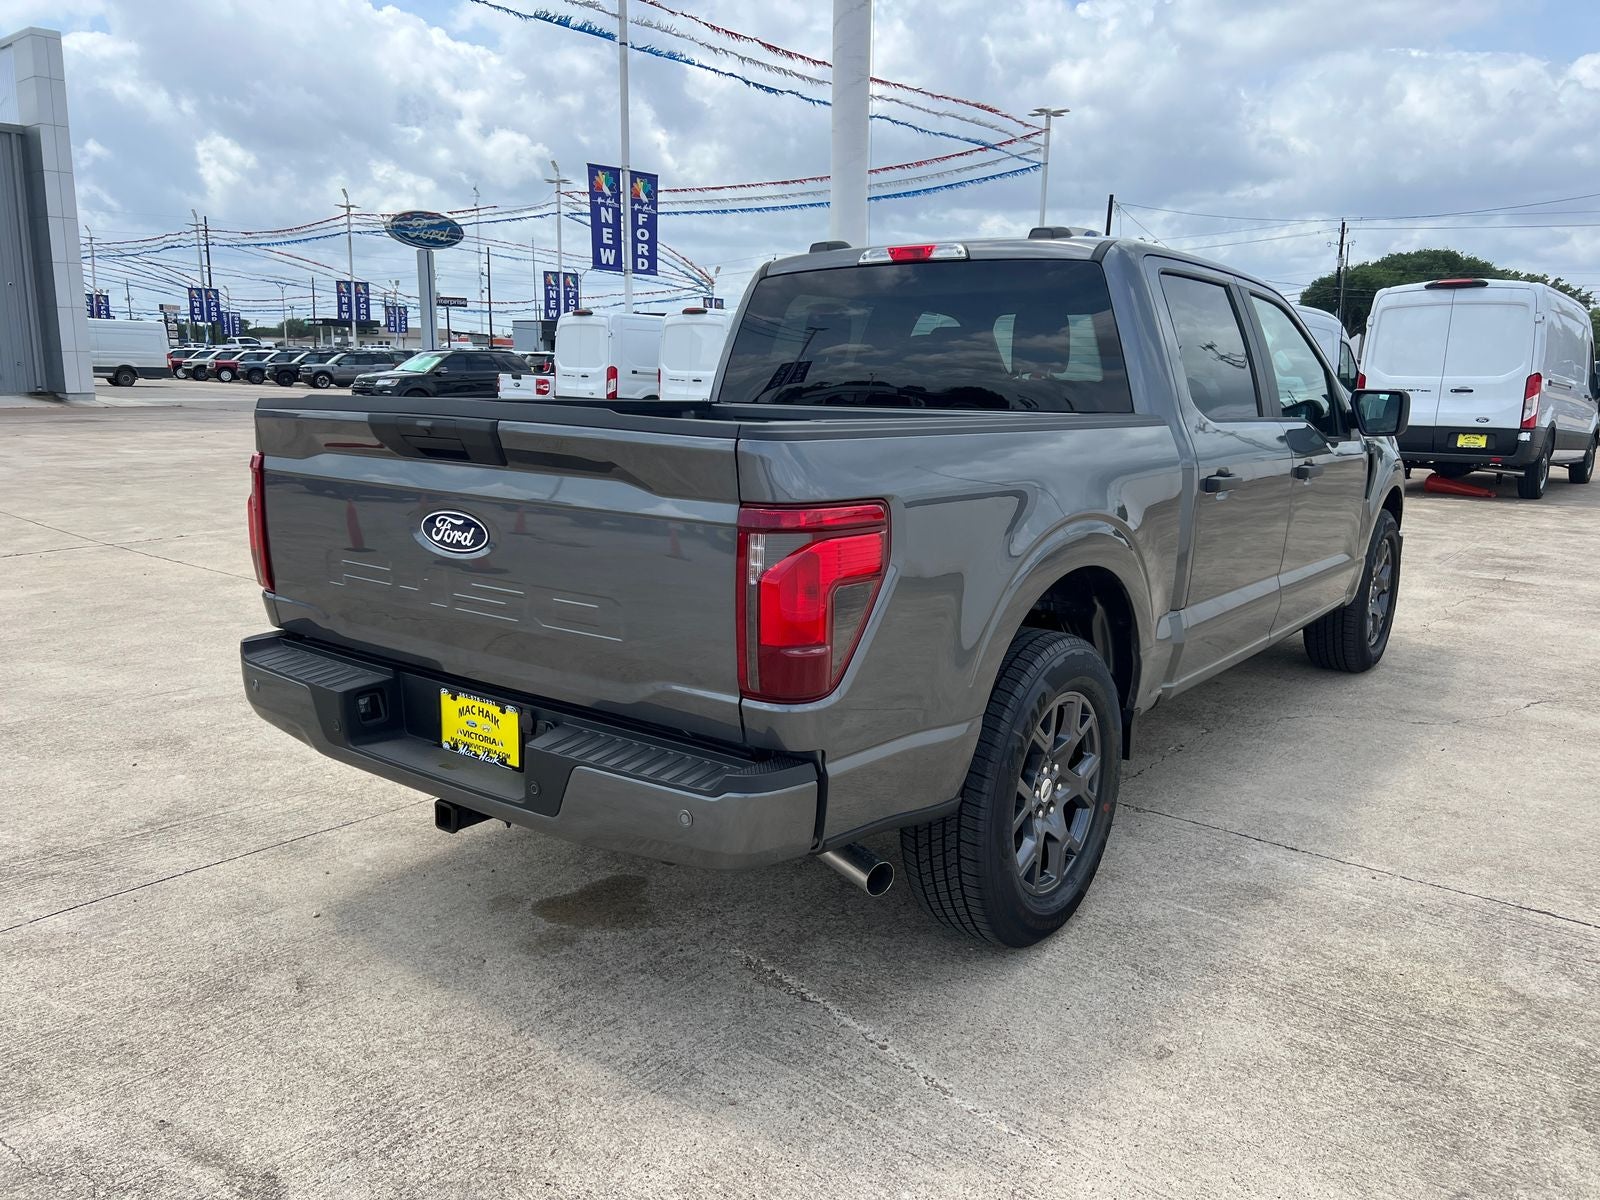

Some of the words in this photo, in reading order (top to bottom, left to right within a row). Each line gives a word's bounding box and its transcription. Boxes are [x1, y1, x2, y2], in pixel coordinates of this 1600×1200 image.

[600, 207, 615, 265] NEW
[637, 213, 649, 270] FORD
[193, 301, 201, 320] NEW
[210, 302, 218, 321] FORD
[341, 297, 349, 319] NEW
[436, 298, 467, 306] nterprise
[548, 290, 557, 318] NEW
[432, 515, 475, 546] Ford
[458, 705, 476, 718] MAC
[478, 706, 500, 729] HAIK
[457, 743, 478, 759] Mac
[479, 751, 507, 767] Haik
